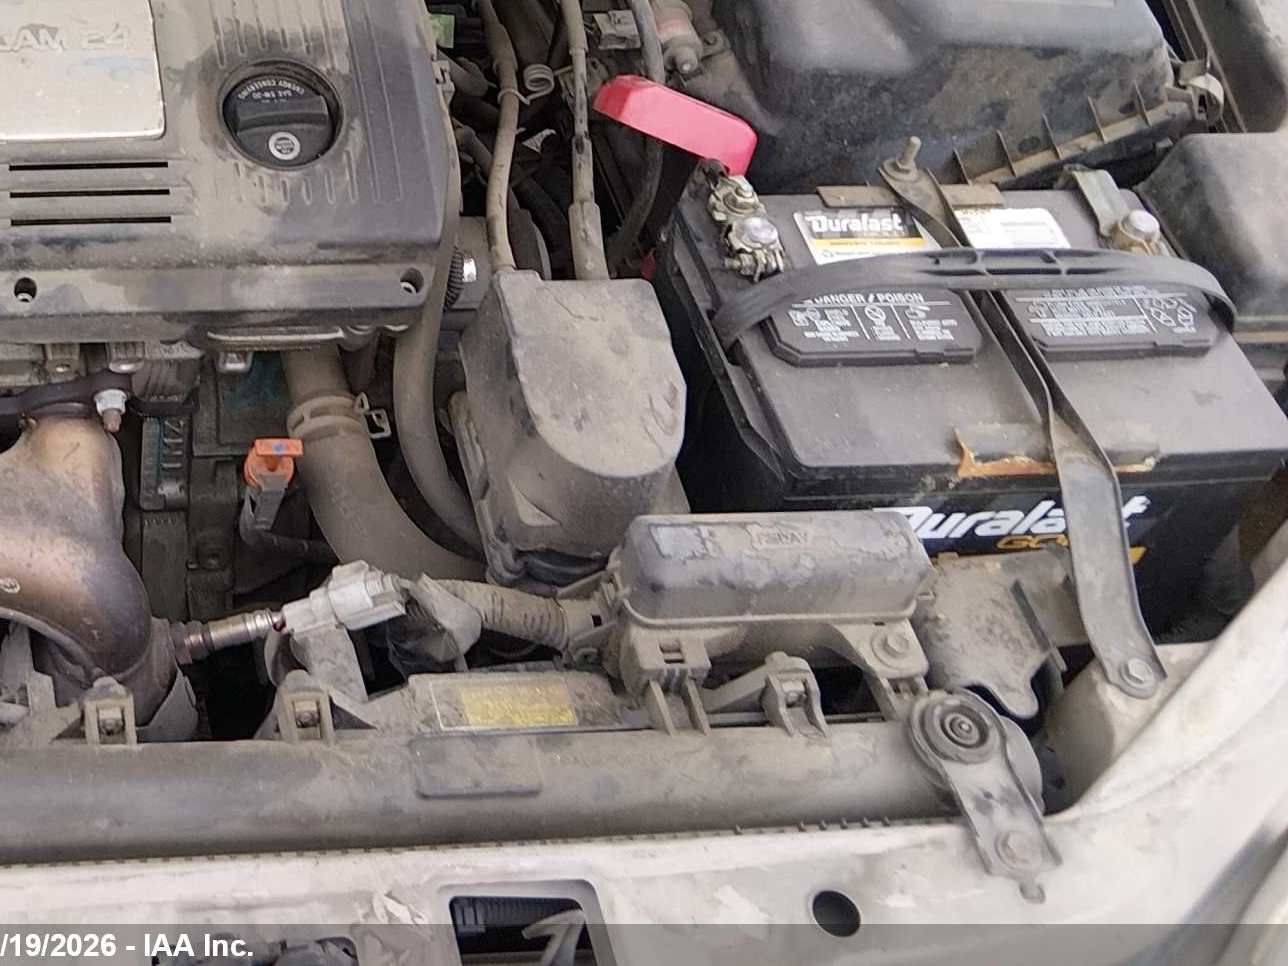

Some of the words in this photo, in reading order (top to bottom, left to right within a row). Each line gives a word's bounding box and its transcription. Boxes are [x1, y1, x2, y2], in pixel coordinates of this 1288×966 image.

[81, 25, 133, 51] 24
[803, 212, 904, 233] Duralast
[876, 292, 925, 304] POISON
[872, 495, 1152, 539] Duralat
